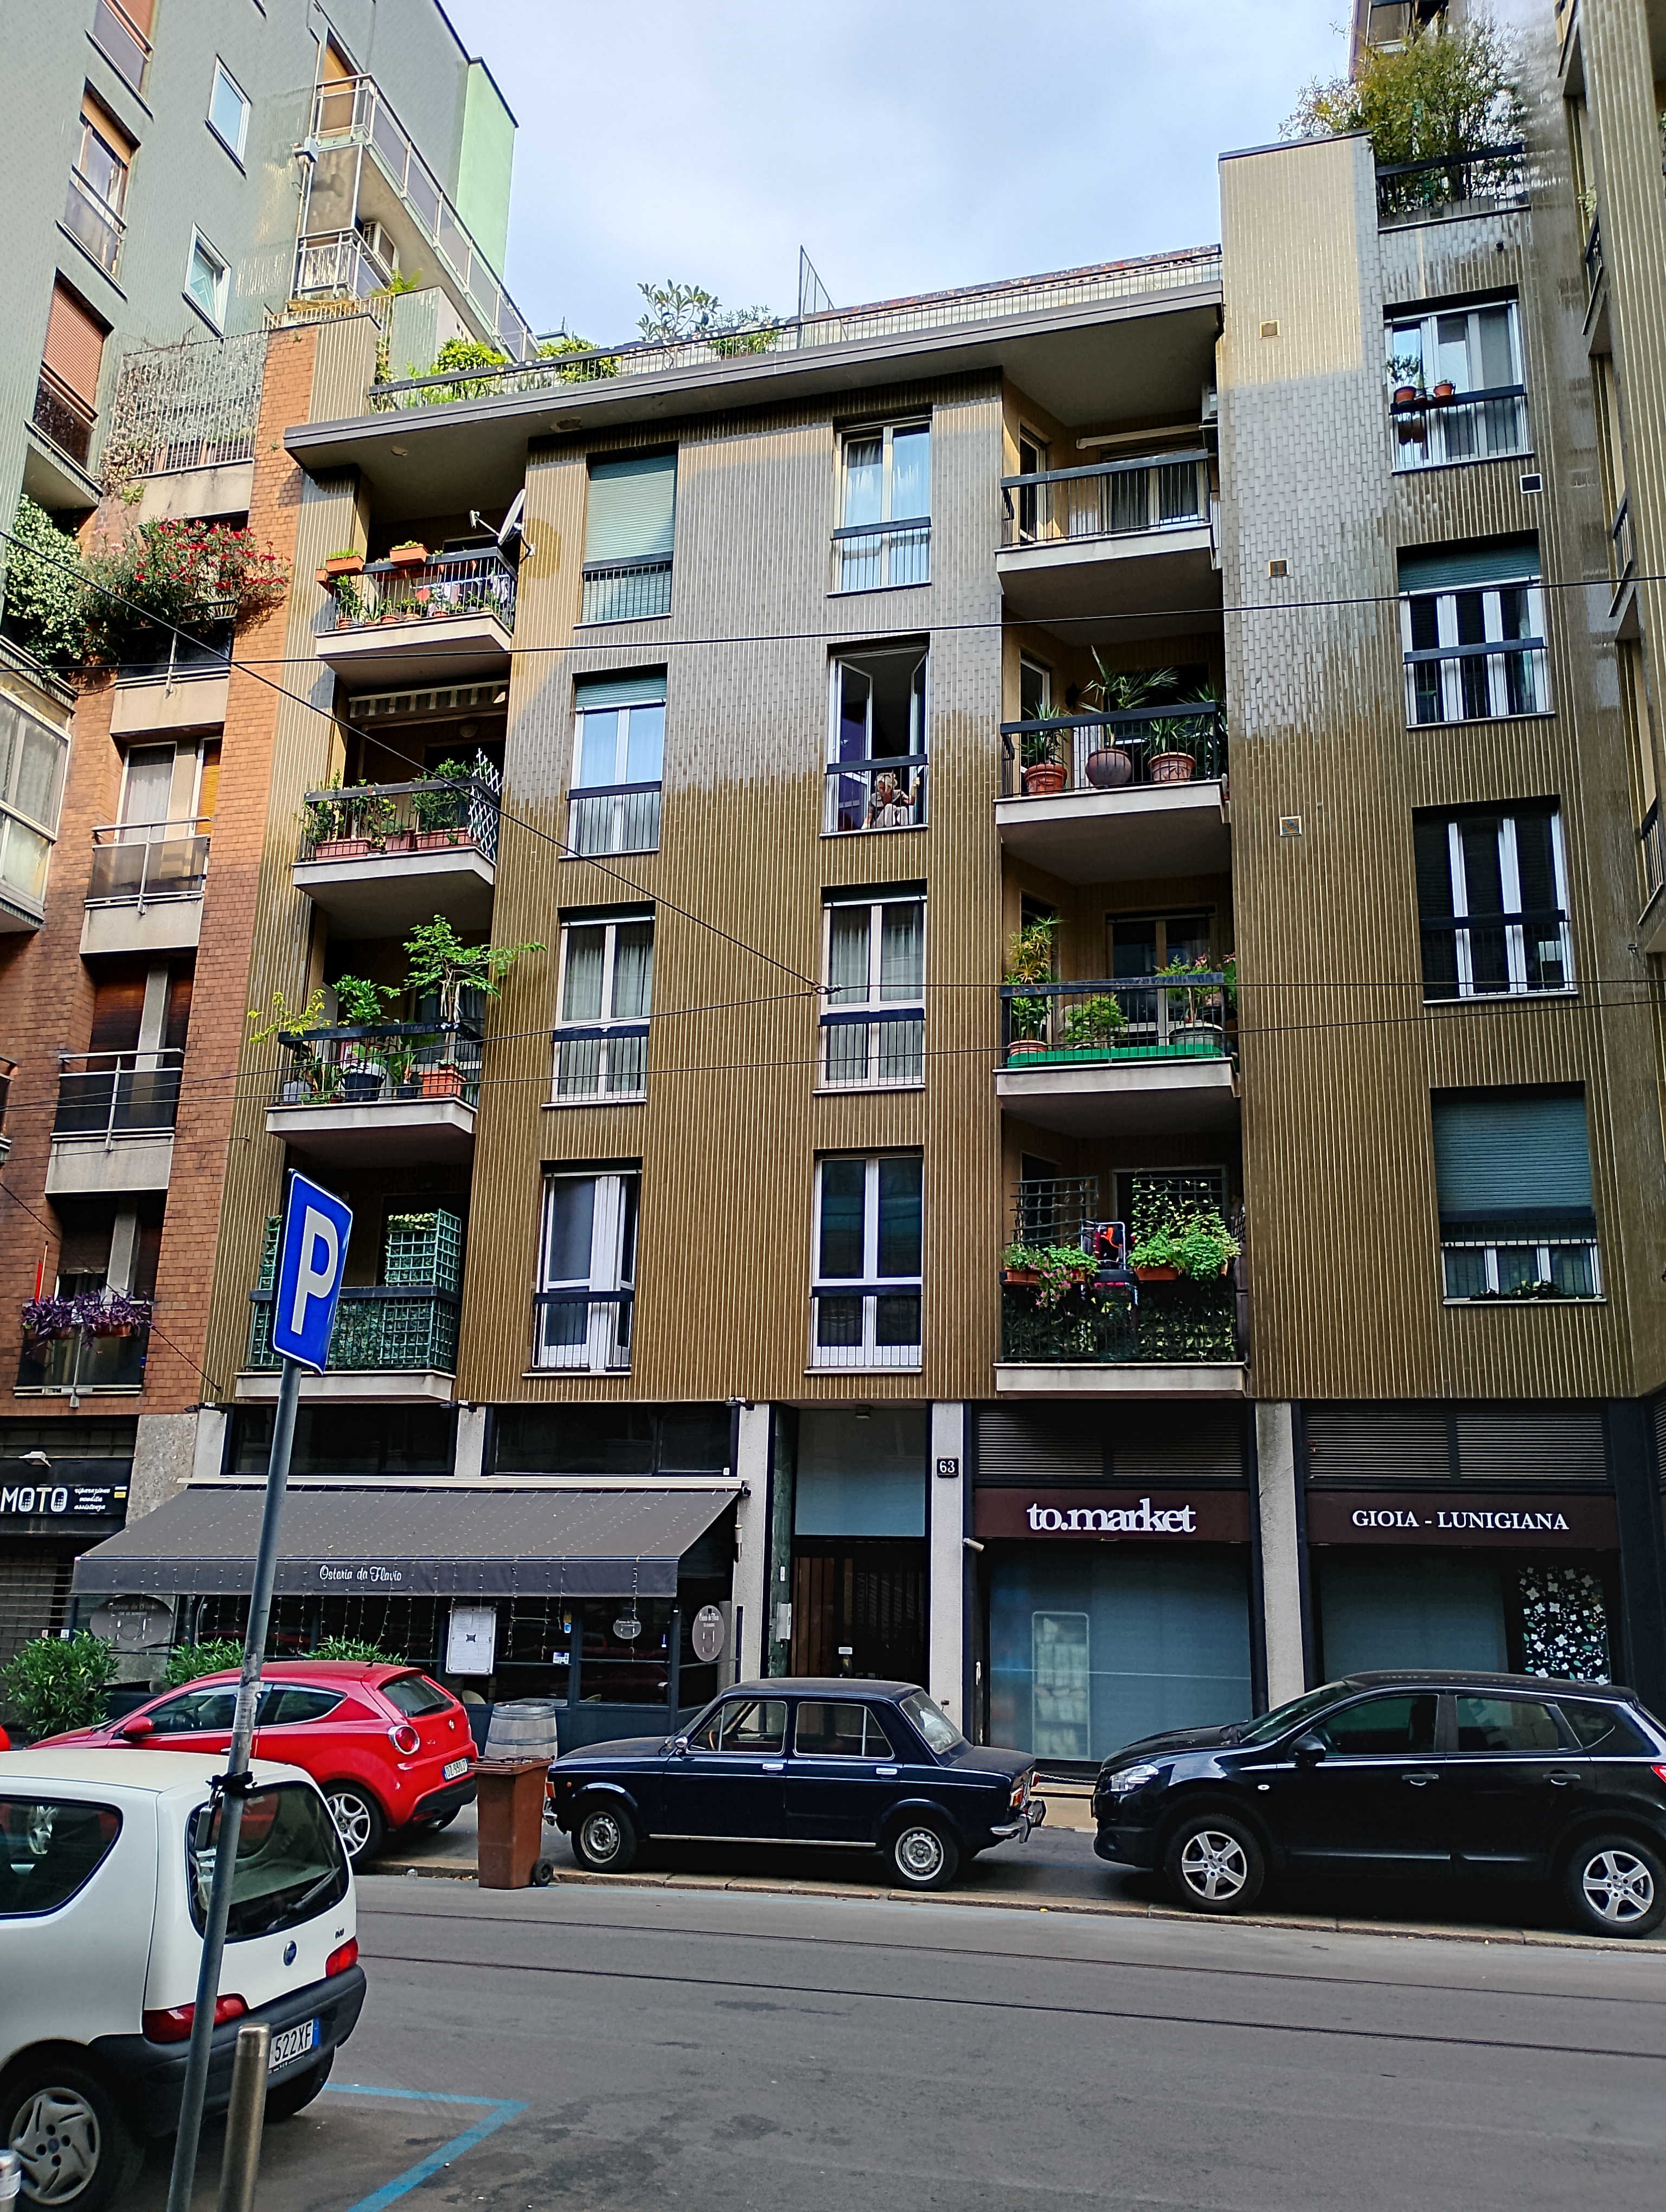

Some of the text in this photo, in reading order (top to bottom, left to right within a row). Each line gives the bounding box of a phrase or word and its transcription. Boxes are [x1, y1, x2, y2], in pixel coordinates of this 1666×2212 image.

[291, 1205, 338, 1335] P
[939, 1460, 956, 1473] 63
[0, 1487, 68, 1512] MOTO
[74, 1503, 106, 1512] assistenza
[1027, 1497, 1196, 1533] to.market
[1352, 1510, 1420, 1527] GIOIA
[1437, 1512, 1569, 1530] LUNIGIANA
[319, 1565, 402, 1582] Osteria da Flavio
[274, 2022, 312, 2062] 522XF
